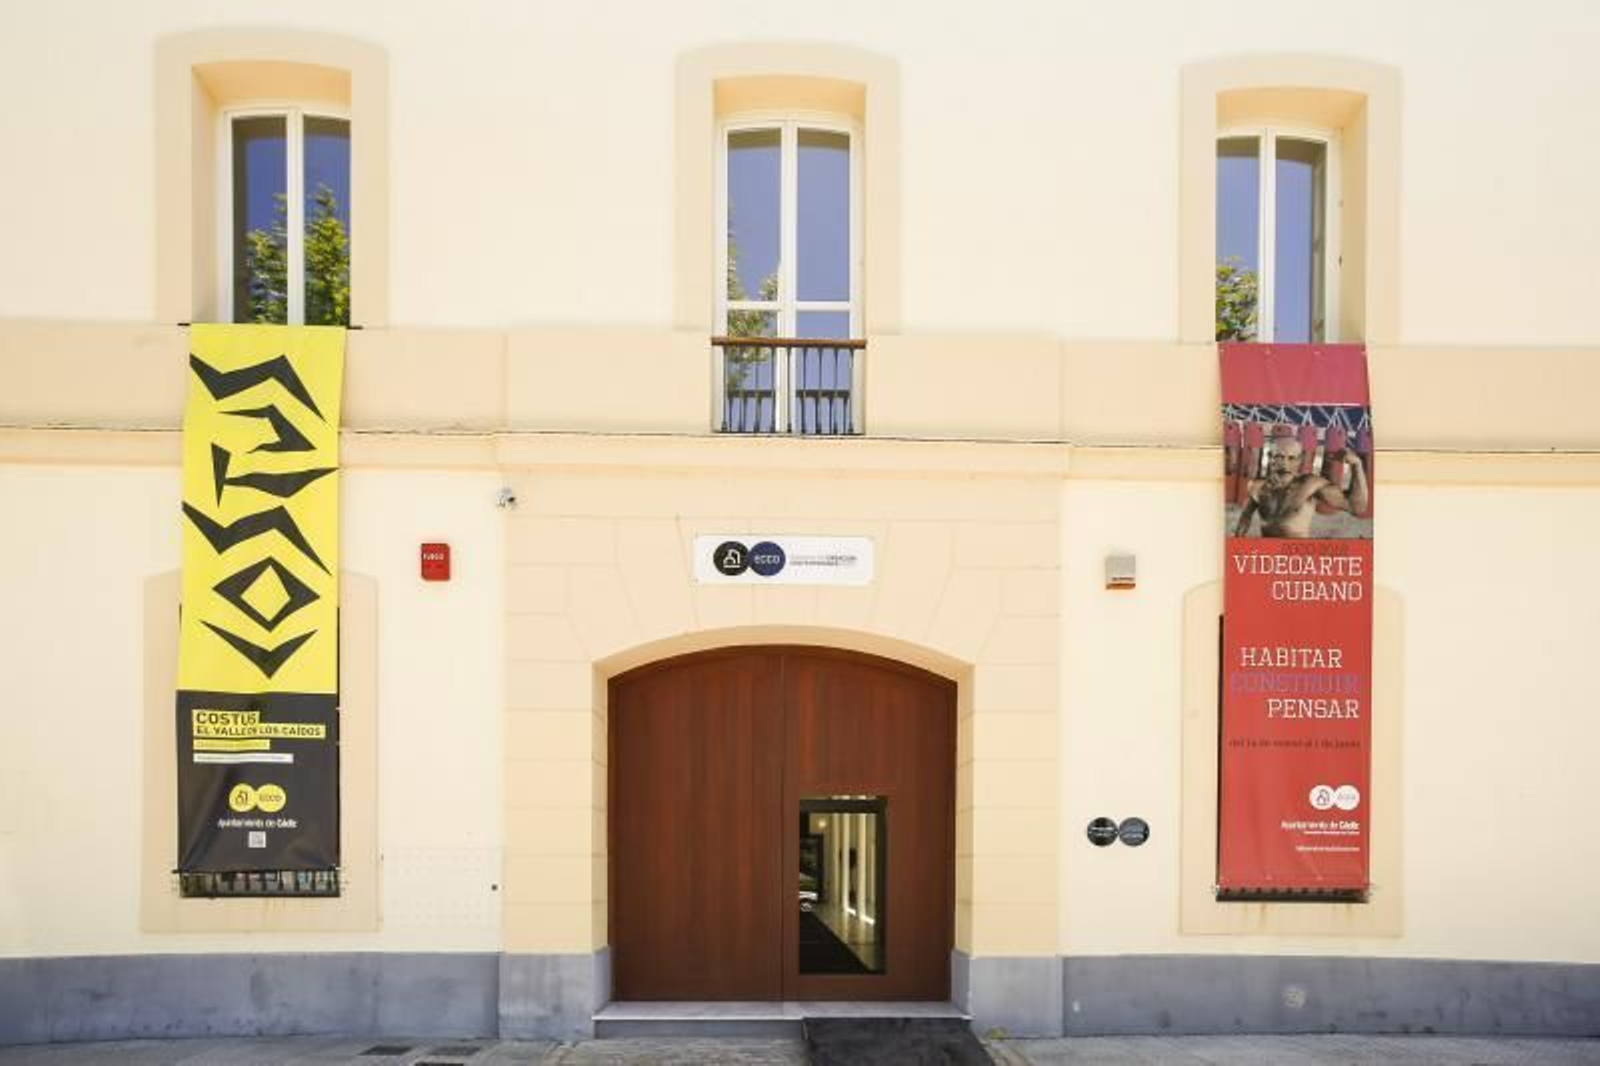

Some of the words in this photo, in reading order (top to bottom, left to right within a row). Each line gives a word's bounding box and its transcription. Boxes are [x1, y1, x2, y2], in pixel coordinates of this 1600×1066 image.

[1233, 551, 1363, 576] VÍDEOARTE
[1272, 581, 1363, 601] CUBANO
[1240, 647, 1343, 669] HABITAR
[196, 712, 257, 726] COSTUS
[1267, 699, 1360, 719] PENSAR
[197, 725, 209, 735] EL
[282, 725, 321, 736] CAÍDOS
